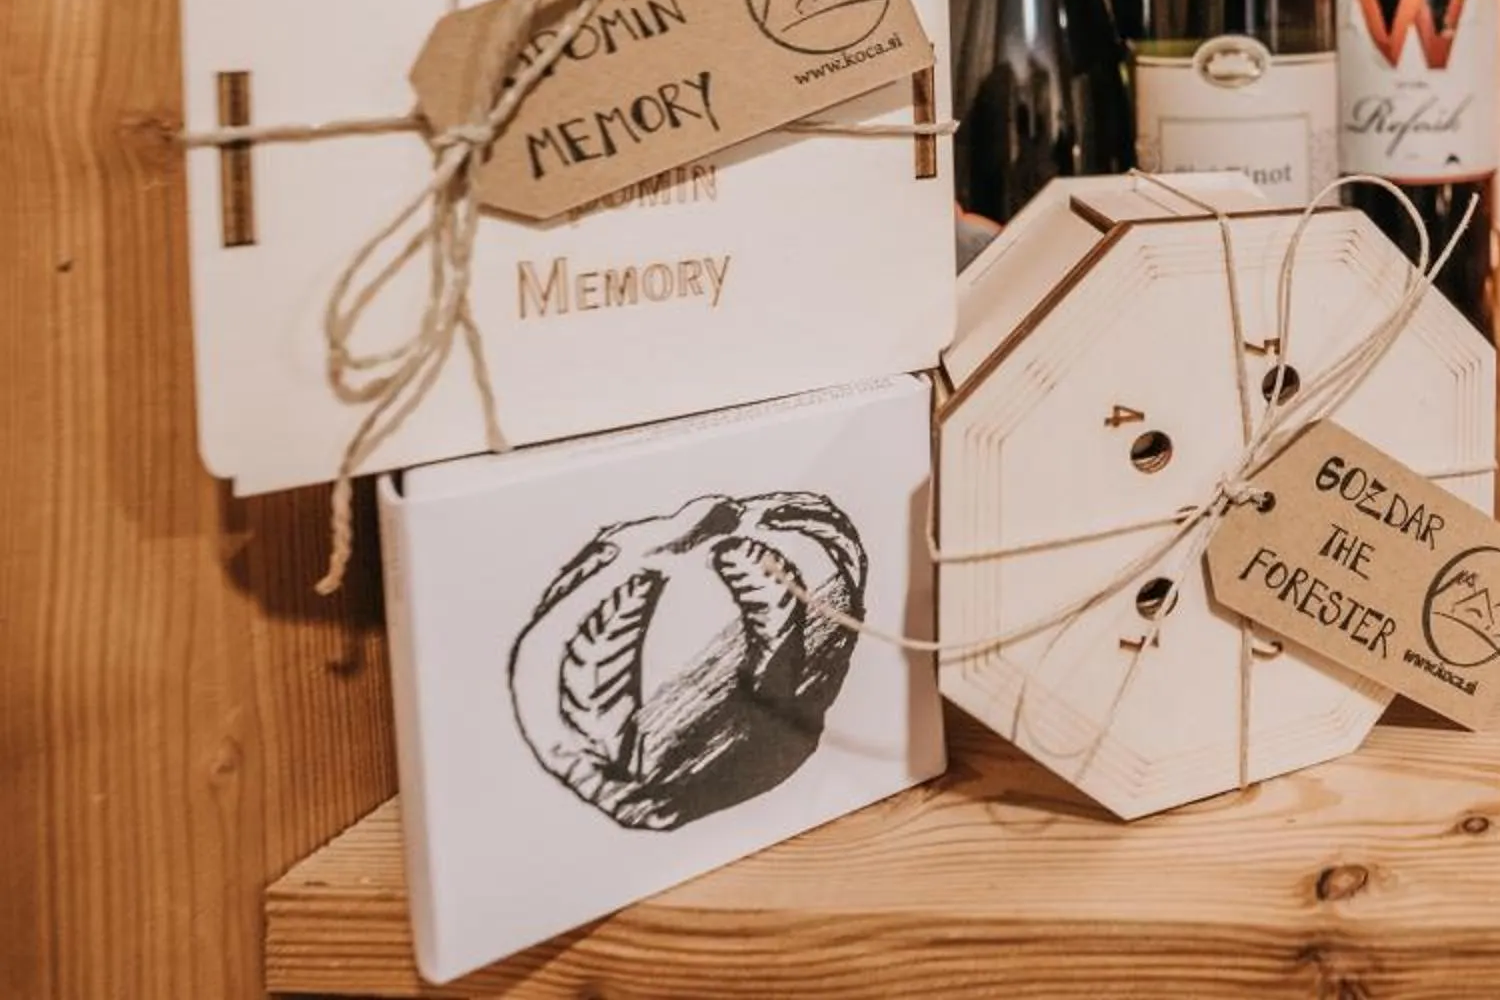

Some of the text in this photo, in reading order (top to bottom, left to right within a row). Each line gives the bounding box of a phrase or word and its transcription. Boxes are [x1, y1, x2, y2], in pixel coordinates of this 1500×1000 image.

[794, 32, 902, 85] www.koca.si
[526, 71, 720, 181] MEMORY
[1315, 456, 1445, 550] GOZDAR
[1318, 522, 1376, 581] THE
[1238, 547, 1396, 659] FORESTER
